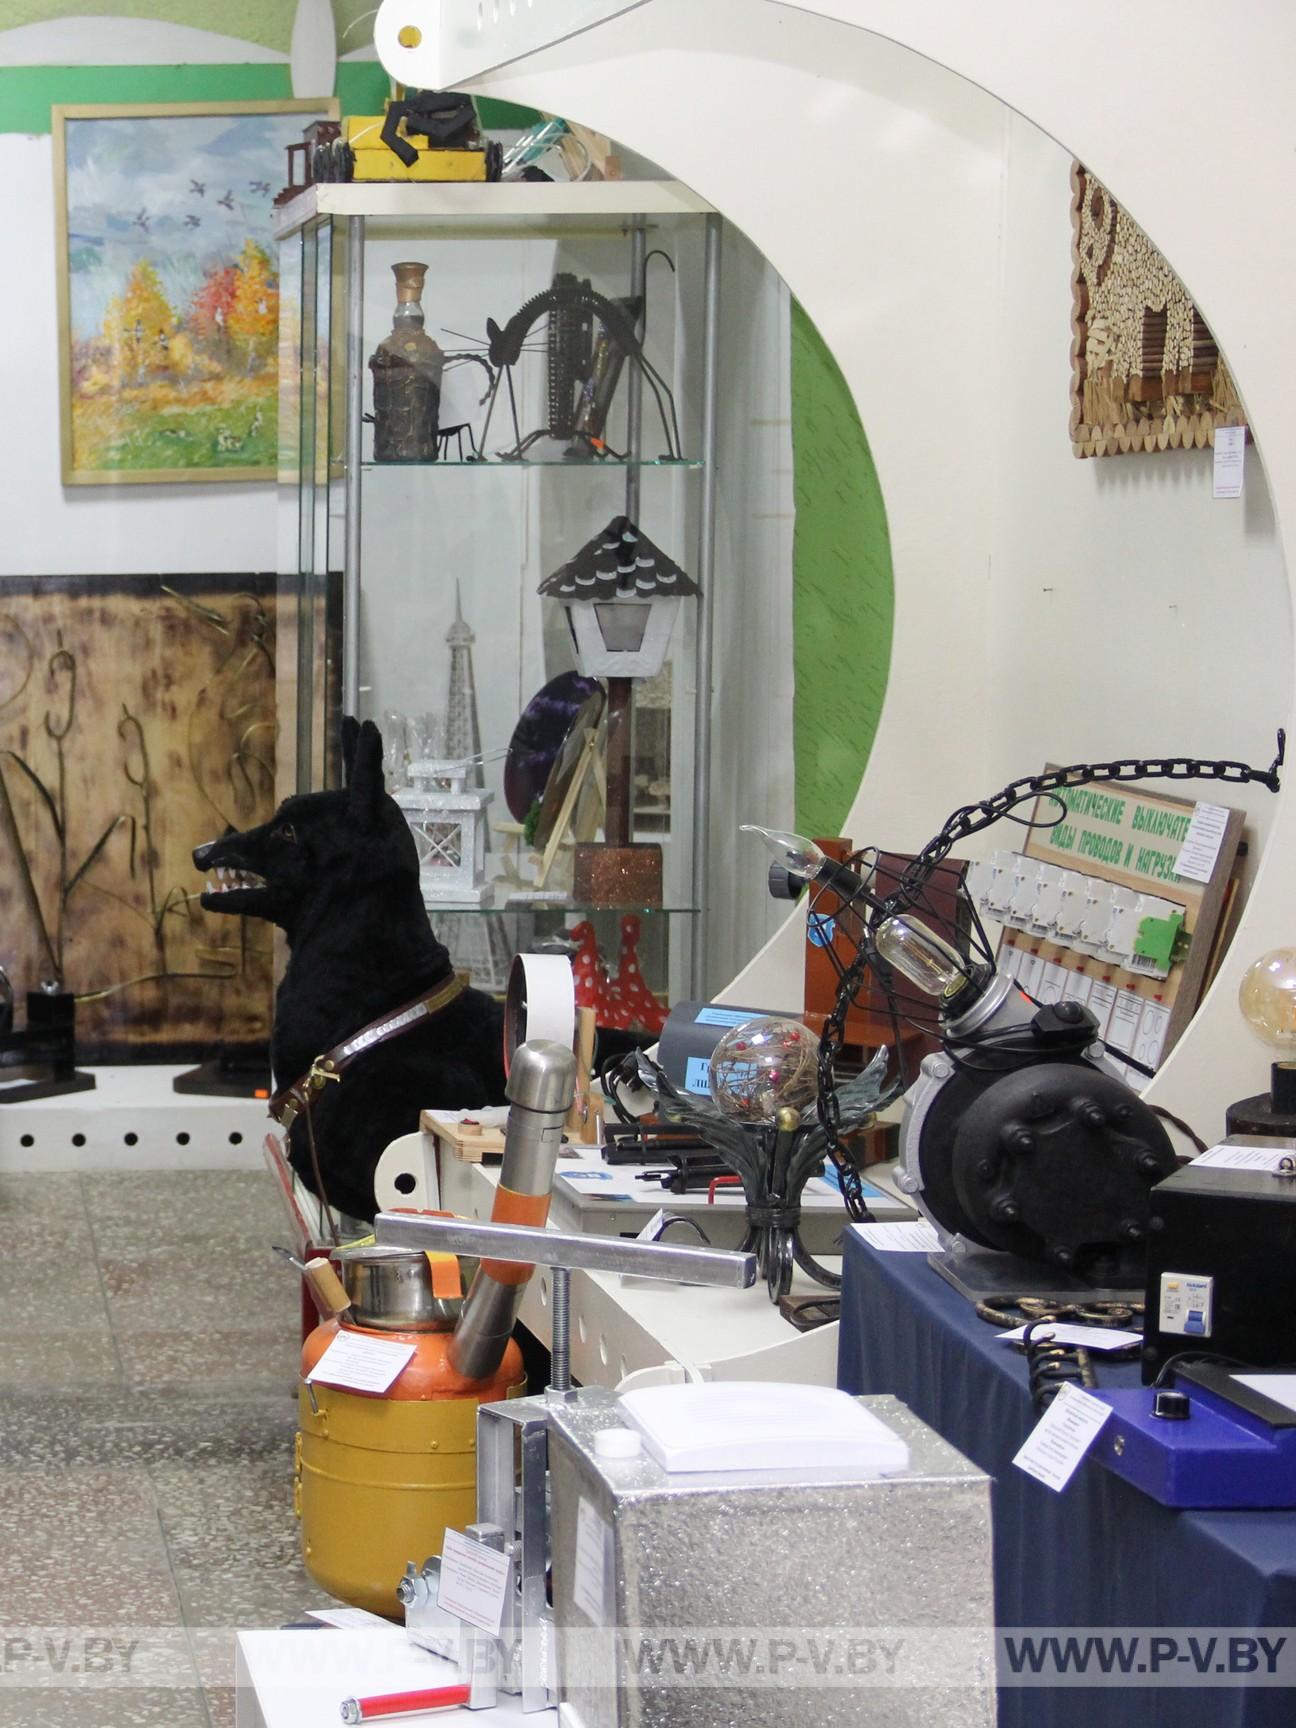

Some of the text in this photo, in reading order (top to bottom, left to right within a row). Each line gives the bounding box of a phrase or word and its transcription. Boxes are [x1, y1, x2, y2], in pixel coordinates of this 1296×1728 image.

[1050, 823, 1077, 849] ВИДЫ
[1077, 830, 1123, 865] ПРОВОДОВ
[1123, 843, 1134, 868] И
